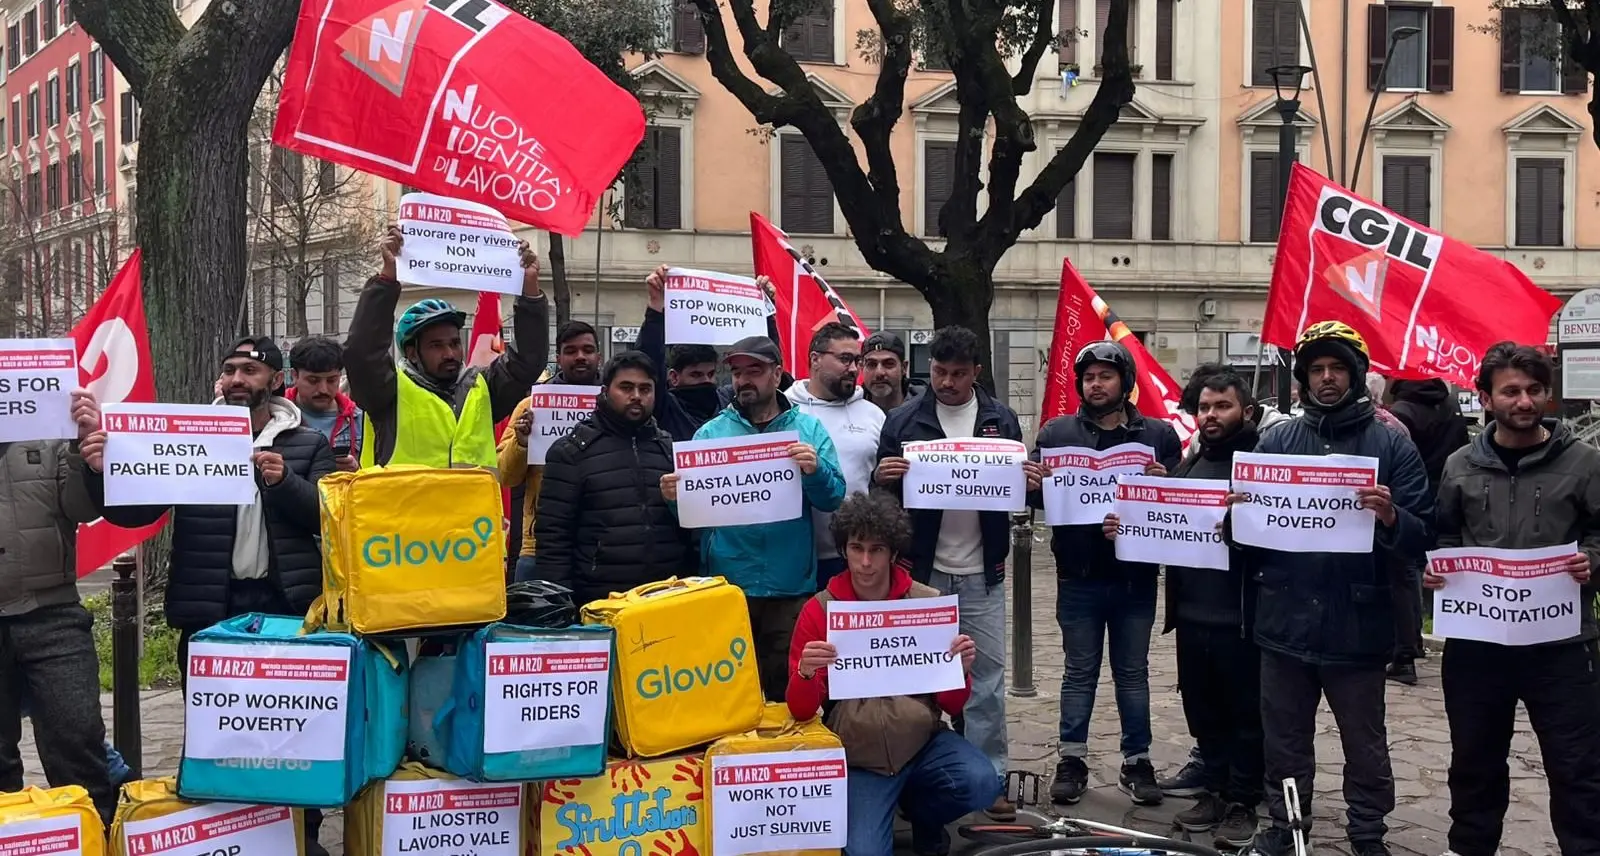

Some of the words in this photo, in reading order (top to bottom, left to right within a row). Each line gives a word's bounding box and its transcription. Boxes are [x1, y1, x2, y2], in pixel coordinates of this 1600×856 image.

[368, 9, 414, 64] N
[443, 84, 545, 159] NUOVE
[445, 158, 556, 212] LAVORO
[402, 207, 413, 219] 14
[418, 207, 452, 222] MARZO
[401, 225, 457, 241] Lavorare
[460, 231, 481, 244] per
[484, 235, 519, 248] vivere
[1321, 196, 1433, 270] CGIL
[446, 246, 476, 258] NON
[410, 259, 431, 270] per
[434, 261, 513, 277] sopravvivere
[670, 277, 680, 289] 14
[683, 278, 710, 291] MARZO
[1346, 260, 1379, 304] N
[670, 299, 704, 310] STOP
[707, 302, 763, 317] WORKING
[691, 315, 746, 328] POVERTY
[1564, 322, 1600, 335] BENVE
[1056, 294, 1082, 416] ww.filcams.cgil.it
[1415, 324, 1482, 371] NUOV
[0, 378, 11, 393] S
[18, 377, 61, 392] FOR
[0, 400, 37, 415] ERS
[534, 396, 545, 408] 14
[549, 395, 579, 408] MARZO
[108, 416, 123, 431] 14
[128, 416, 169, 432] MARZO
[552, 411, 563, 421] IL
[567, 411, 594, 422] NOS
[541, 426, 575, 437] LAVO
[153, 443, 207, 456] BASTA
[679, 453, 691, 467] 14
[695, 450, 729, 466] MARZO
[918, 454, 959, 464] WORK
[963, 454, 981, 464] TO
[985, 455, 1013, 465] LIVE
[1045, 457, 1056, 468] 14
[1060, 454, 1090, 468] MARZO
[110, 462, 170, 476] PAGHE
[175, 463, 200, 476] DA
[204, 463, 249, 477] FAME
[951, 469, 979, 479] NOT
[1237, 465, 1249, 480] 14
[1254, 466, 1292, 482] MARZO
[685, 475, 732, 491] BASTA
[736, 468, 794, 487] LAVORO
[1054, 471, 1075, 487] PIÙ
[1080, 472, 1143, 487] SALA
[711, 489, 771, 507] POVERO
[918, 483, 952, 494] JUST
[955, 485, 1011, 496] SURVIVE
[1127, 486, 1159, 502] MARZO
[1298, 497, 1364, 511] LAVORO
[1147, 511, 1188, 525] BASTA
[1266, 514, 1336, 529] POVERO
[1117, 524, 1222, 544] SFRUTTAMENTO
[363, 532, 477, 568] Glovo
[1435, 559, 1449, 572] 14
[1454, 558, 1493, 574] MARZO
[1481, 583, 1532, 602] STOP
[1441, 599, 1575, 623] EXPLOITATION
[832, 614, 845, 629] 14
[849, 613, 884, 629] MARZO
[870, 636, 917, 650] BASTA
[192, 657, 207, 675] 14
[212, 658, 256, 677] MARZO
[493, 658, 505, 674] 14
[510, 656, 543, 673] MARZO
[834, 651, 954, 671] SFRUTTAMENTO
[636, 661, 735, 700] Glovo
[502, 682, 563, 700] RIGHTS
[567, 680, 598, 696] FOR
[191, 692, 240, 707] STOP
[245, 694, 339, 710] WORKING
[521, 704, 581, 722] RIDERS
[218, 716, 308, 732] POVERTY
[718, 770, 730, 784] 14
[735, 766, 770, 783] MARZO
[728, 787, 774, 802] WORK
[778, 786, 798, 799] TO
[802, 784, 832, 797] LIVE
[390, 796, 403, 812] 14
[408, 793, 444, 811] MARZO
[765, 804, 796, 817] NOT
[413, 816, 426, 830] IL
[430, 811, 499, 828] NOSTRO
[730, 824, 767, 839] JUST
[769, 820, 832, 834] SURVIVE
[131, 837, 147, 854] 14
[151, 825, 197, 851] MARZO
[399, 833, 465, 852] LAVORO
[470, 831, 510, 846] VALE
